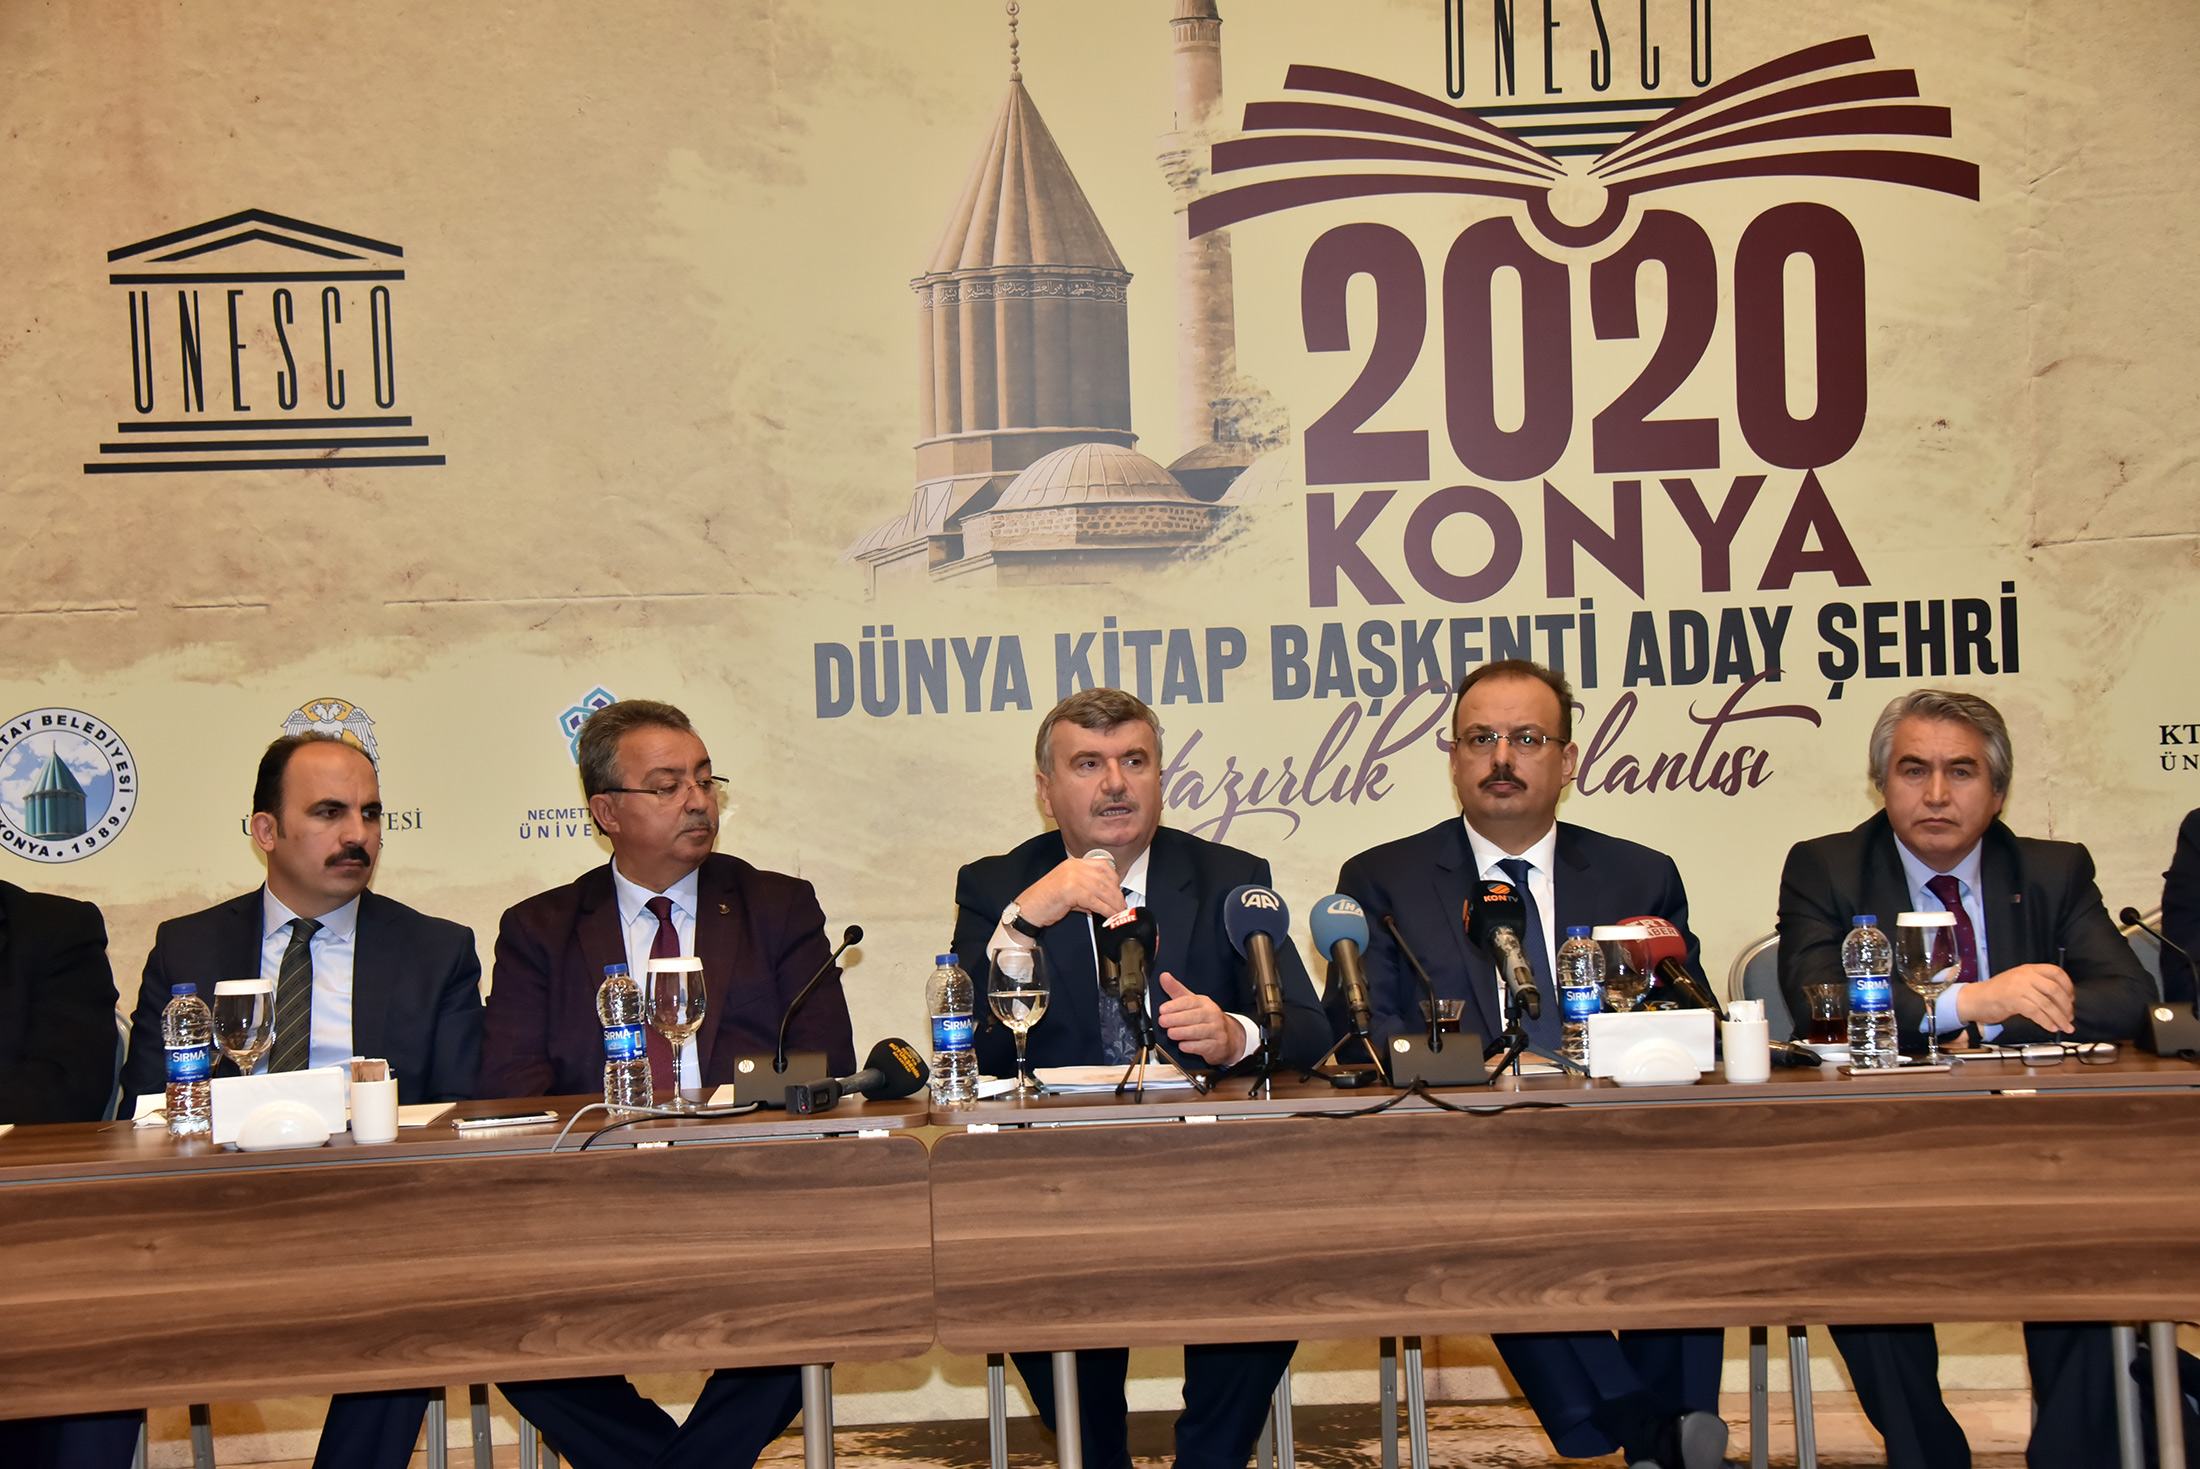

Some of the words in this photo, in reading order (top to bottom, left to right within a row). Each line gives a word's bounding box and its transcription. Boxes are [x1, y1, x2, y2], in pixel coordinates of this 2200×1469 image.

[1445, 0, 1711, 99] UNESCO
[129, 285, 395, 414] UNESCO
[1301, 201, 1868, 486] 2020
[1306, 468, 1871, 607] KONYA
[814, 624, 1033, 718] DÜNYA
[1054, 616, 1247, 706] KİTAP
[1270, 597, 1598, 716] BAŞKENTİ
[1622, 605, 1793, 688] ADAY
[1817, 581, 2020, 699] ŞEHRİ
[0, 719, 31, 752] TAY
[41, 715, 134, 793] BELEDİYESİ
[1436, 668, 1821, 797] lantısı
[71, 816, 120, 853] 1989
[528, 808, 592, 820] NECMETT
[1243, 892, 1279, 911] AA
